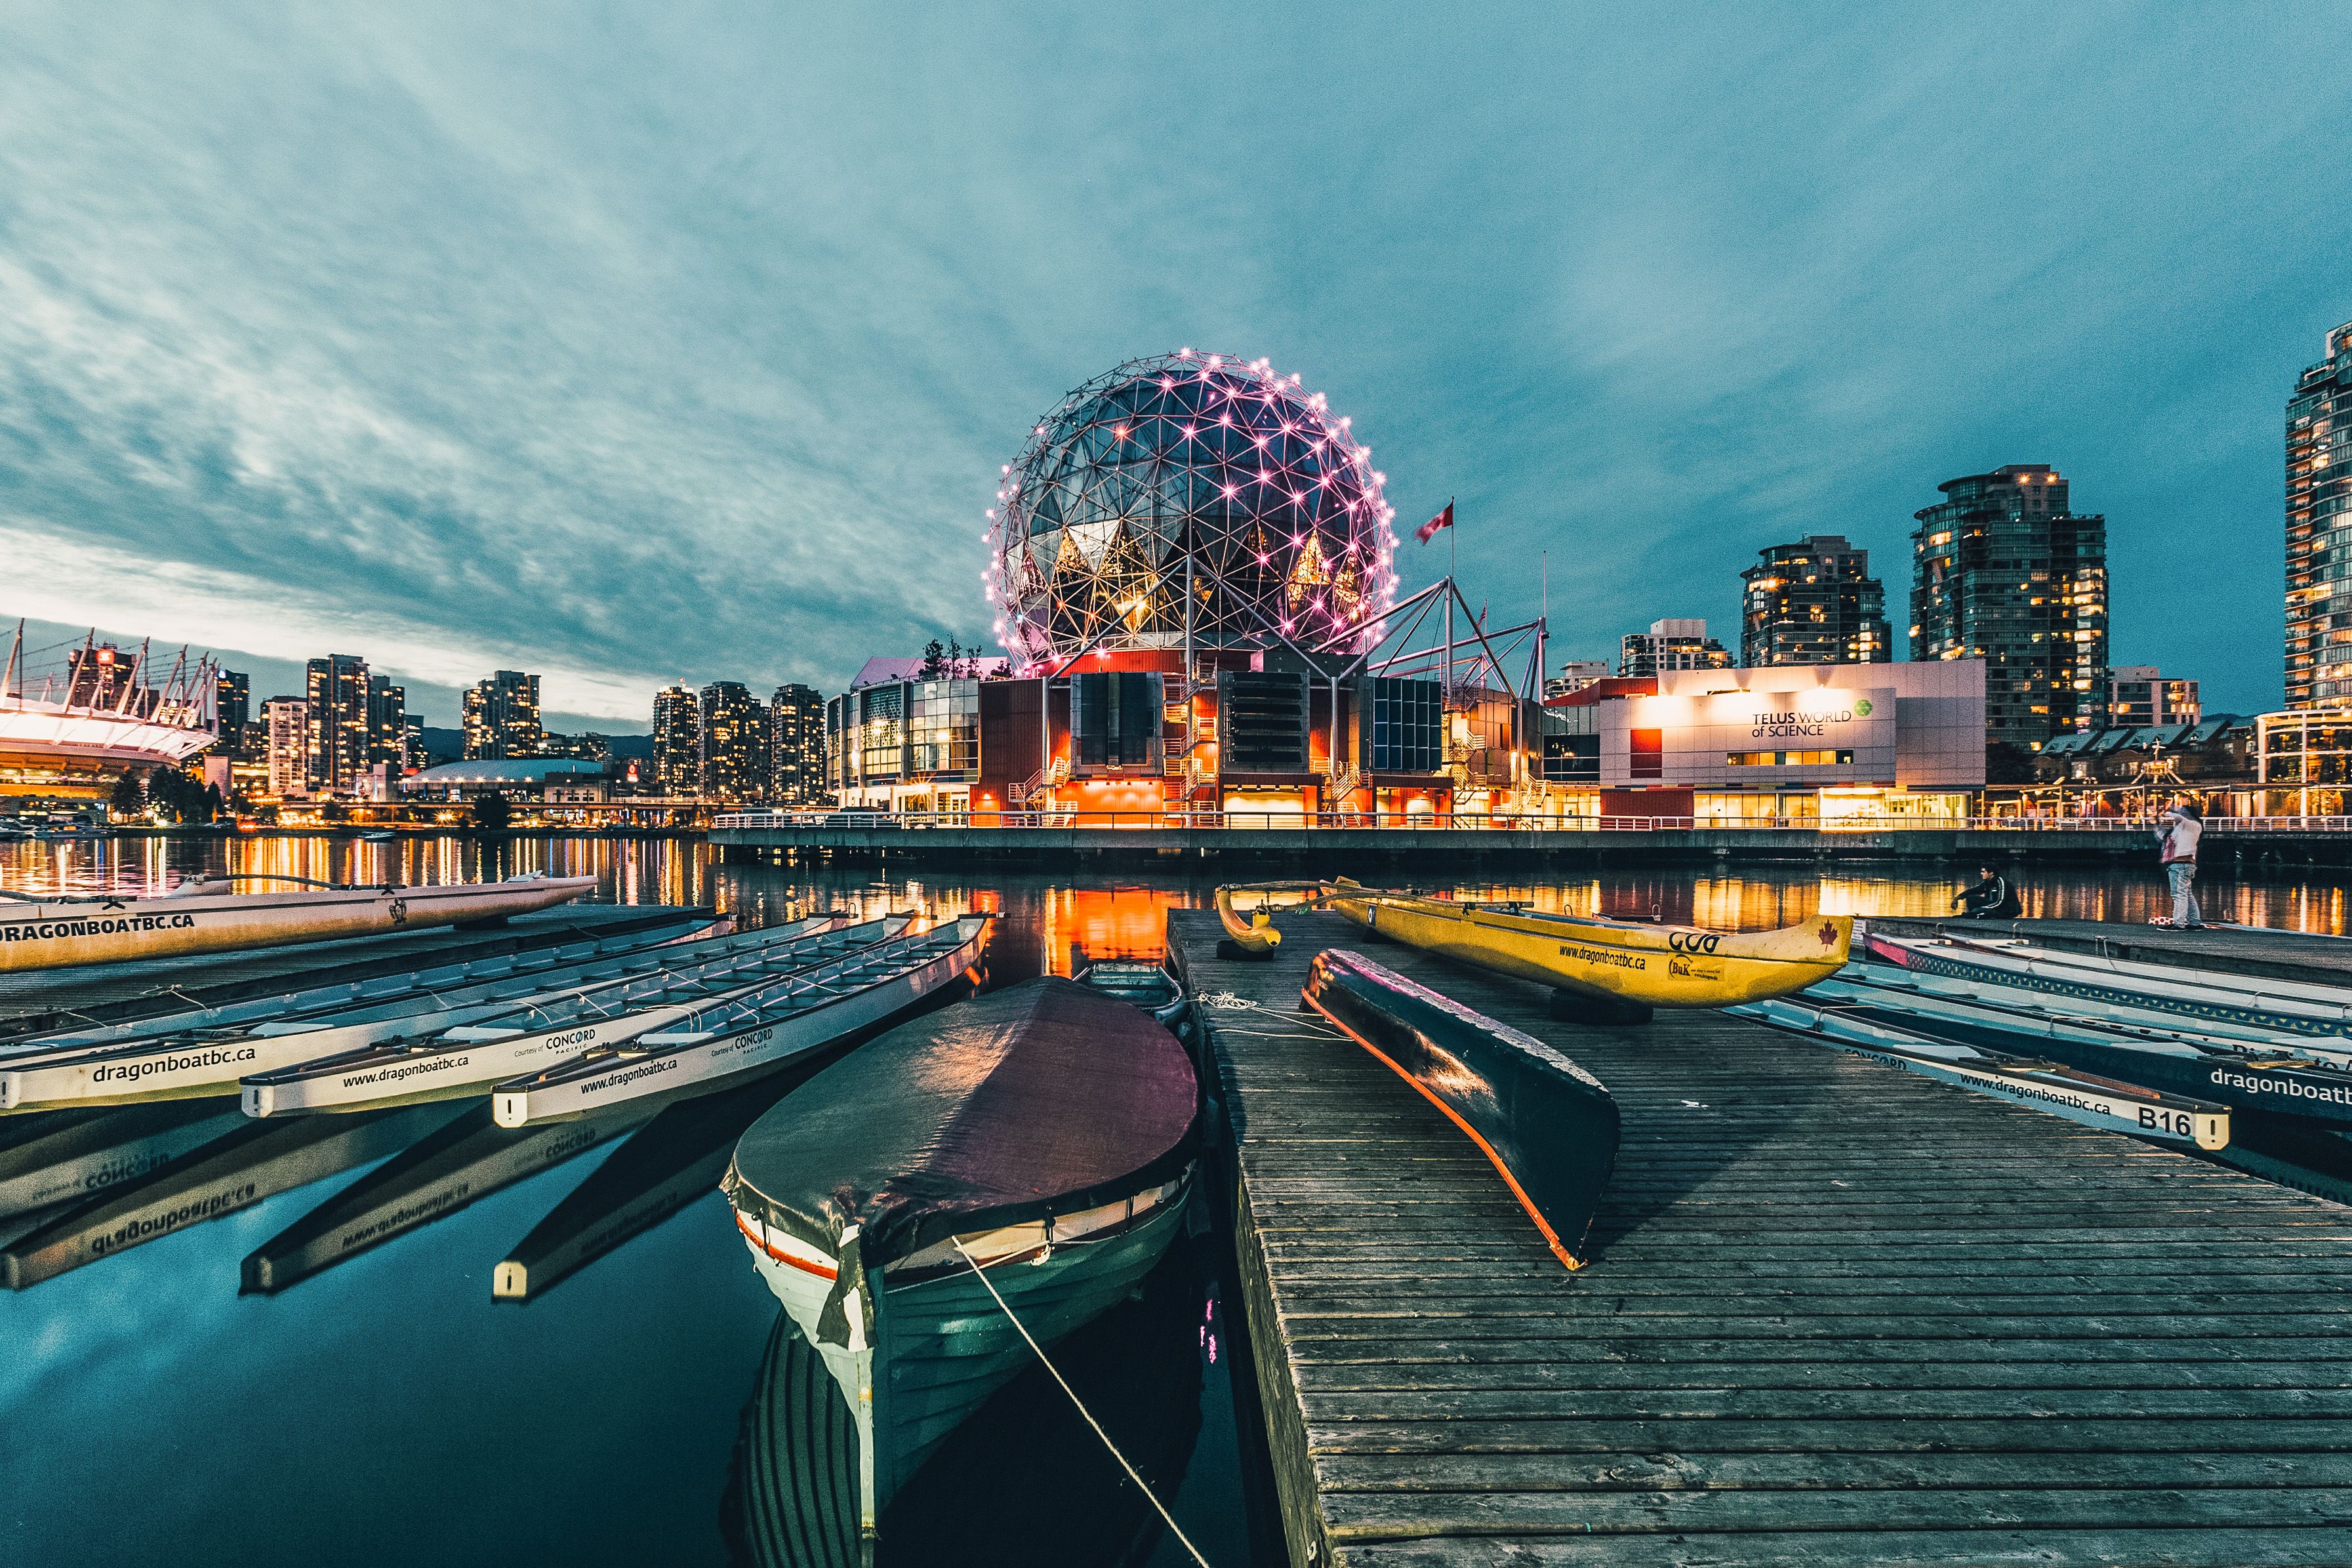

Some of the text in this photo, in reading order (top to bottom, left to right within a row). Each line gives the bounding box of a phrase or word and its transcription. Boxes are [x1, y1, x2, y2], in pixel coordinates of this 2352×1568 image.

[1753, 710, 1852, 725] TELUS WORLD
[1752, 724, 1824, 737] of SCIENCE
[0, 914, 195, 942] RAGONBOATBC.CA
[1560, 945, 1646, 970] www.dragonboatbc.ca
[514, 1044, 544, 1057] Courtesy of
[546, 1029, 596, 1050] CONCORD
[556, 1043, 588, 1055] PACIFIC
[735, 1028, 773, 1050] CONCORD
[93, 1047, 256, 1082] dragonboatbc.ca
[343, 1056, 469, 1088] www.dragonboatbc.ca
[581, 1059, 678, 1095] www.dragonboatbc.ca
[1960, 1073, 2111, 1116] www.dragonboatbc.ca
[2138, 1106, 2191, 1137] B16
